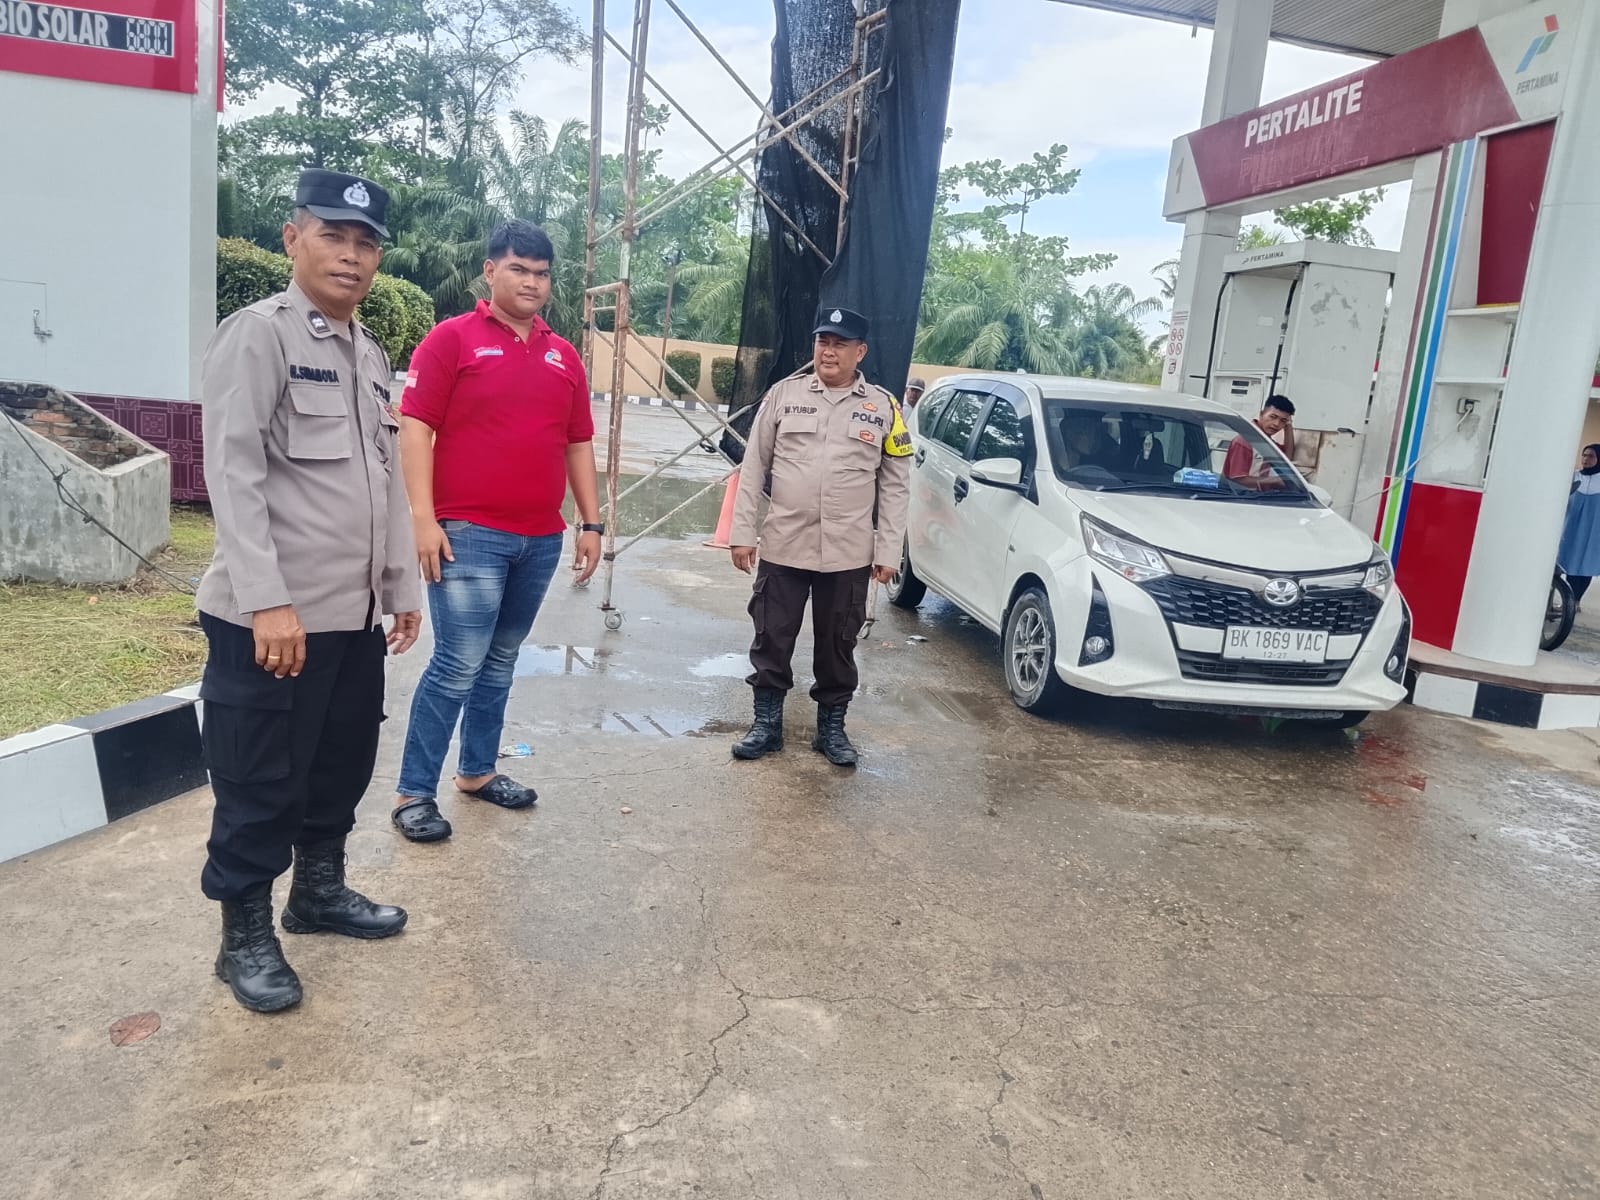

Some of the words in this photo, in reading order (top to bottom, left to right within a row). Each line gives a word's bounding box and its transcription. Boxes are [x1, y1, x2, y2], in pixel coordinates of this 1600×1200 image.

[37, 7, 109, 47] SOLAR
[126, 17, 168, 55] 6800
[1515, 71, 1559, 95] PERTAMINA
[1244, 80, 1364, 148] PERTALITE
[852, 411, 884, 427] POLRI
[1230, 629, 1251, 648] BK
[1255, 631, 1291, 650] 1869
[1296, 632, 1324, 652] VAC
